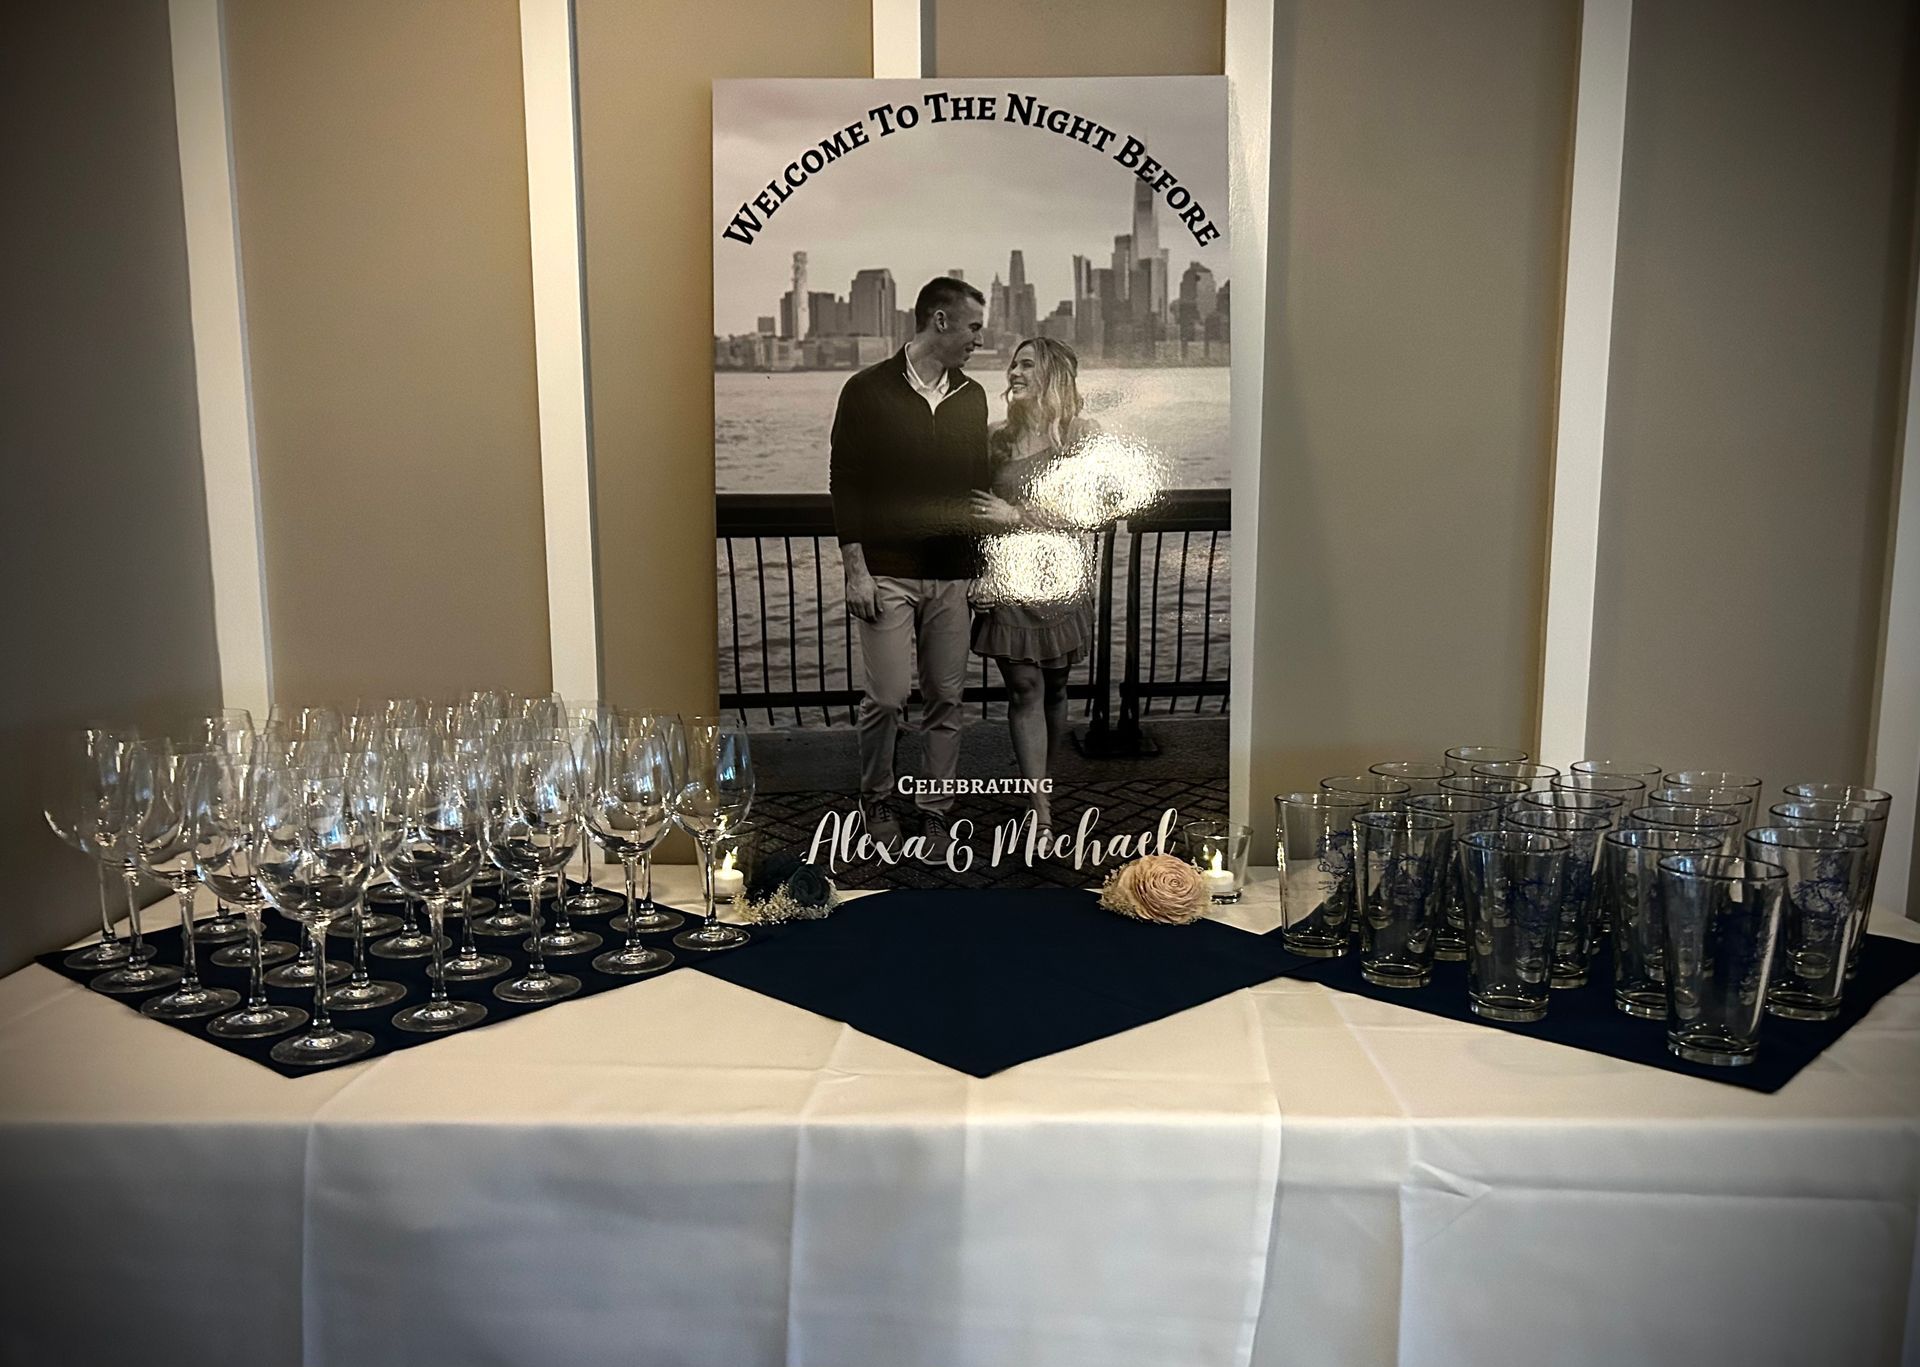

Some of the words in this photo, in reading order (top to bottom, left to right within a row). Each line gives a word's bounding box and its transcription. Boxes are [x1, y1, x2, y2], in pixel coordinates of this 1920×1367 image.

[723, 120, 870, 246] WELCOME
[923, 92, 997, 123] THE
[1003, 93, 1117, 153] NIGHT
[1111, 135, 1221, 248] BEFORE
[897, 775, 1053, 795] CELEBRATING
[801, 810, 934, 874] Alexa
[946, 818, 975, 873] &
[991, 806, 1177, 871] Michael
